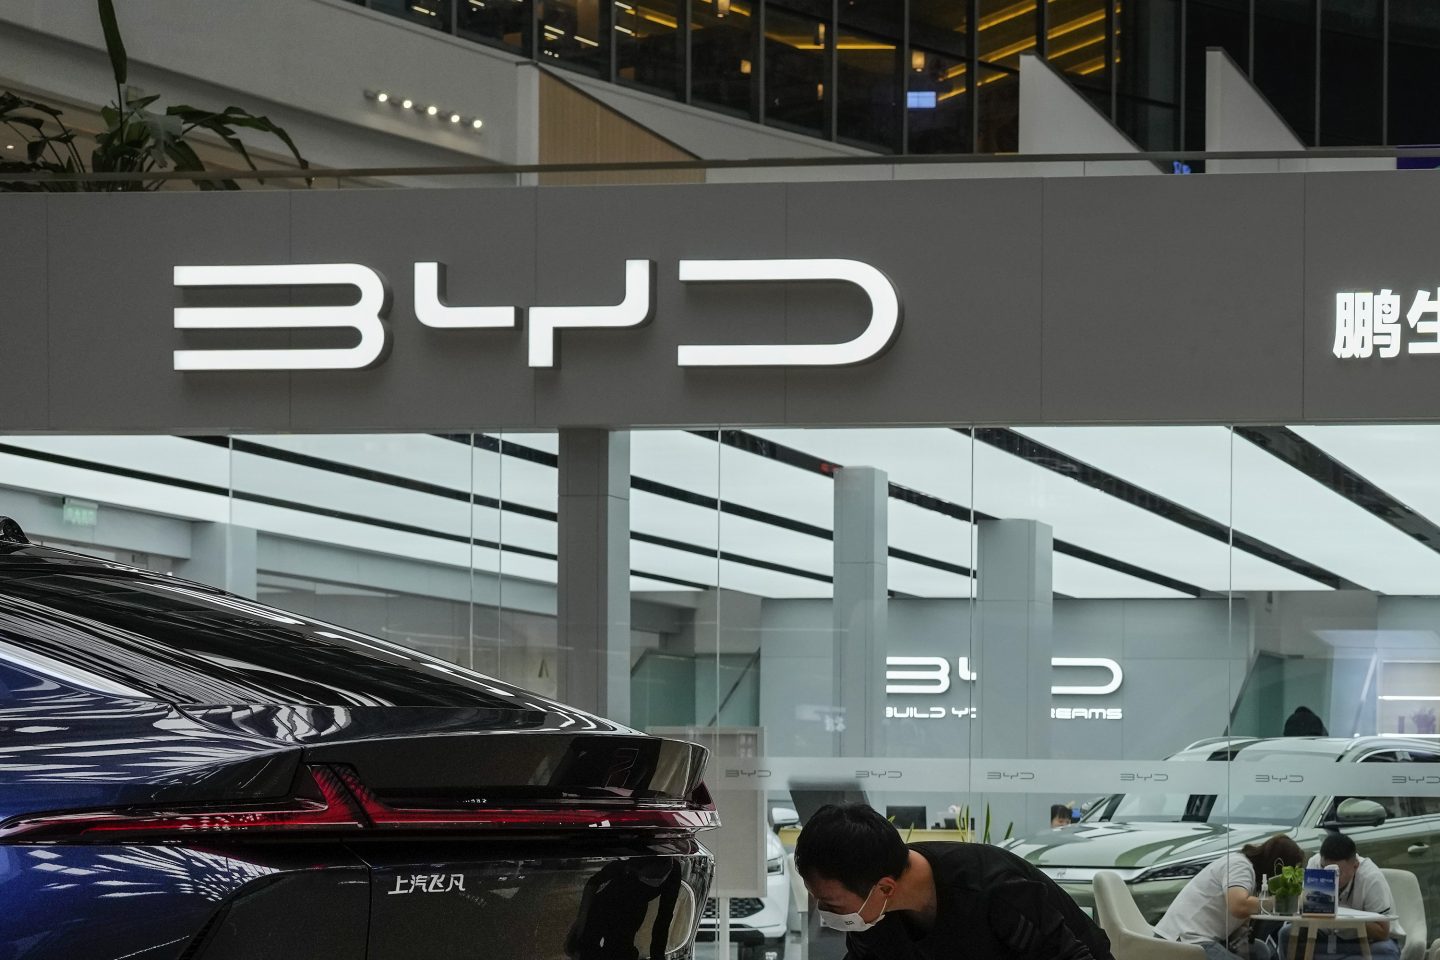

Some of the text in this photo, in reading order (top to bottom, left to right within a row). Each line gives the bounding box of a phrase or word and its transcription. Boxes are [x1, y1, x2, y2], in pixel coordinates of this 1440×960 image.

[173, 258, 899, 370] BYD
[725, 769, 772, 778] BYD
[855, 770, 902, 779] BYD
[986, 771, 1035, 780] BYD
[1119, 773, 1169, 782] BYD
[1255, 774, 1304, 783] BYD
[387, 873, 466, 895] 上汽飞凡
